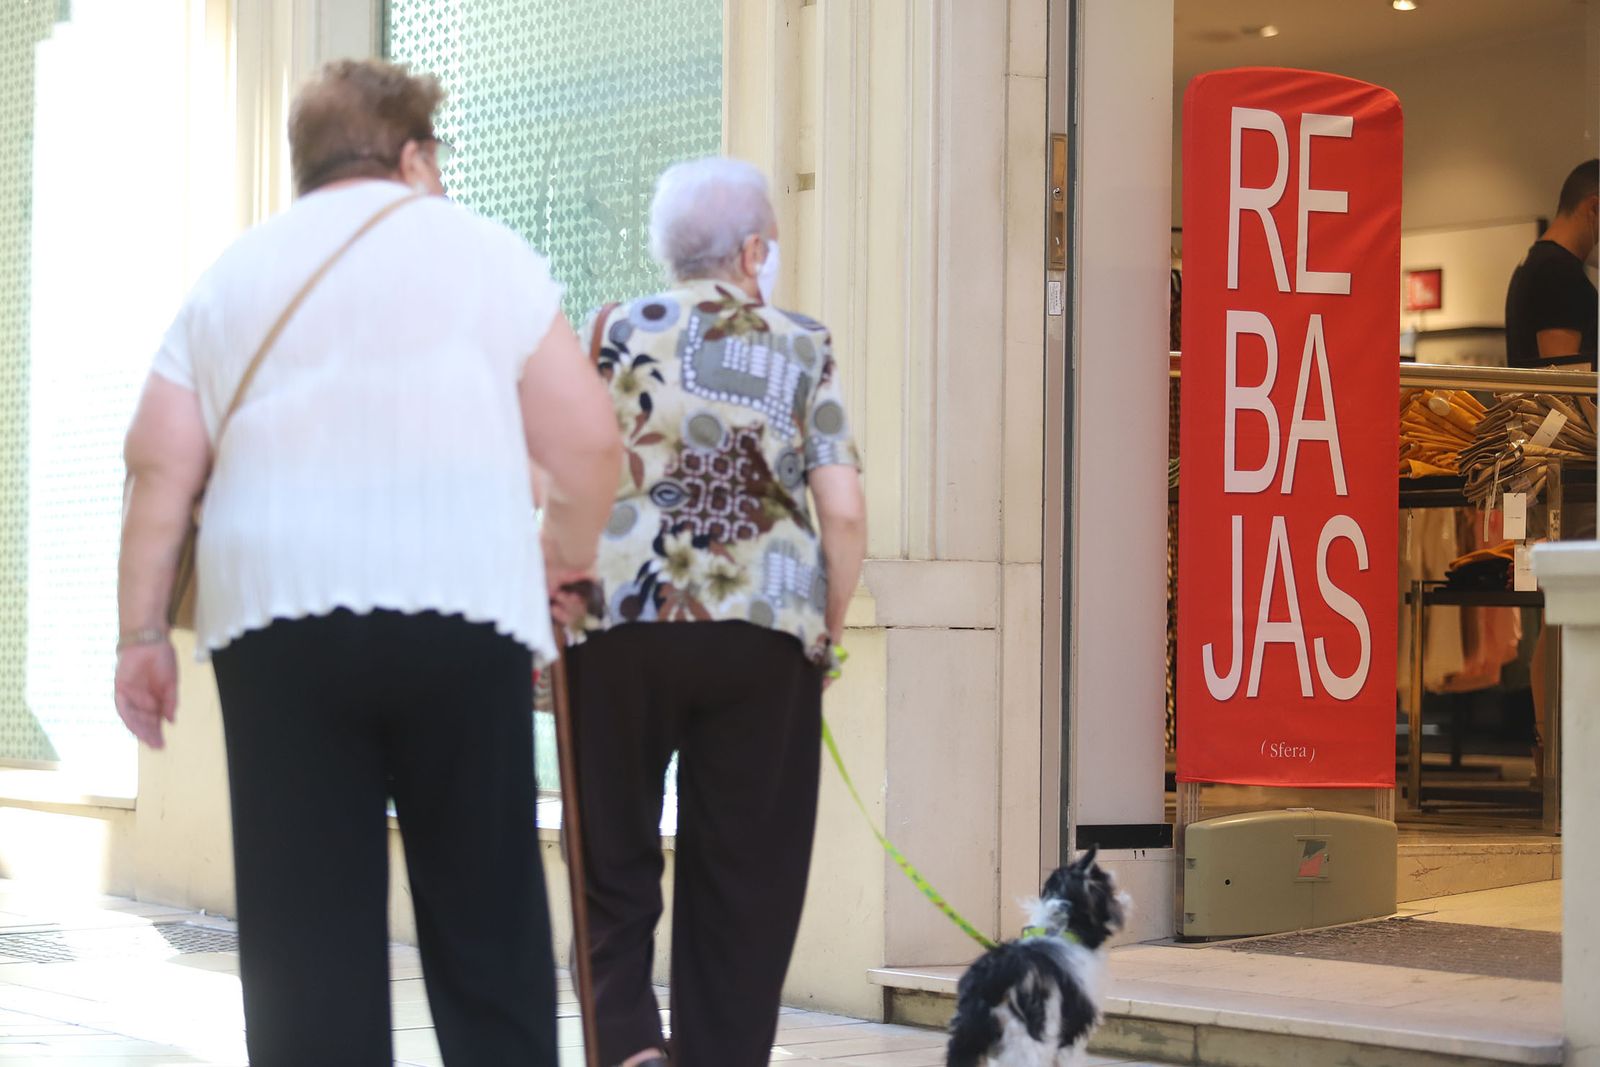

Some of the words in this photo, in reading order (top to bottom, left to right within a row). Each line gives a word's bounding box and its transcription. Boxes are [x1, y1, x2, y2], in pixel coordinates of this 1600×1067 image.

[1226, 106, 1356, 296] RE
[1223, 309, 1349, 497] BA
[1201, 513, 1372, 702] JAS
